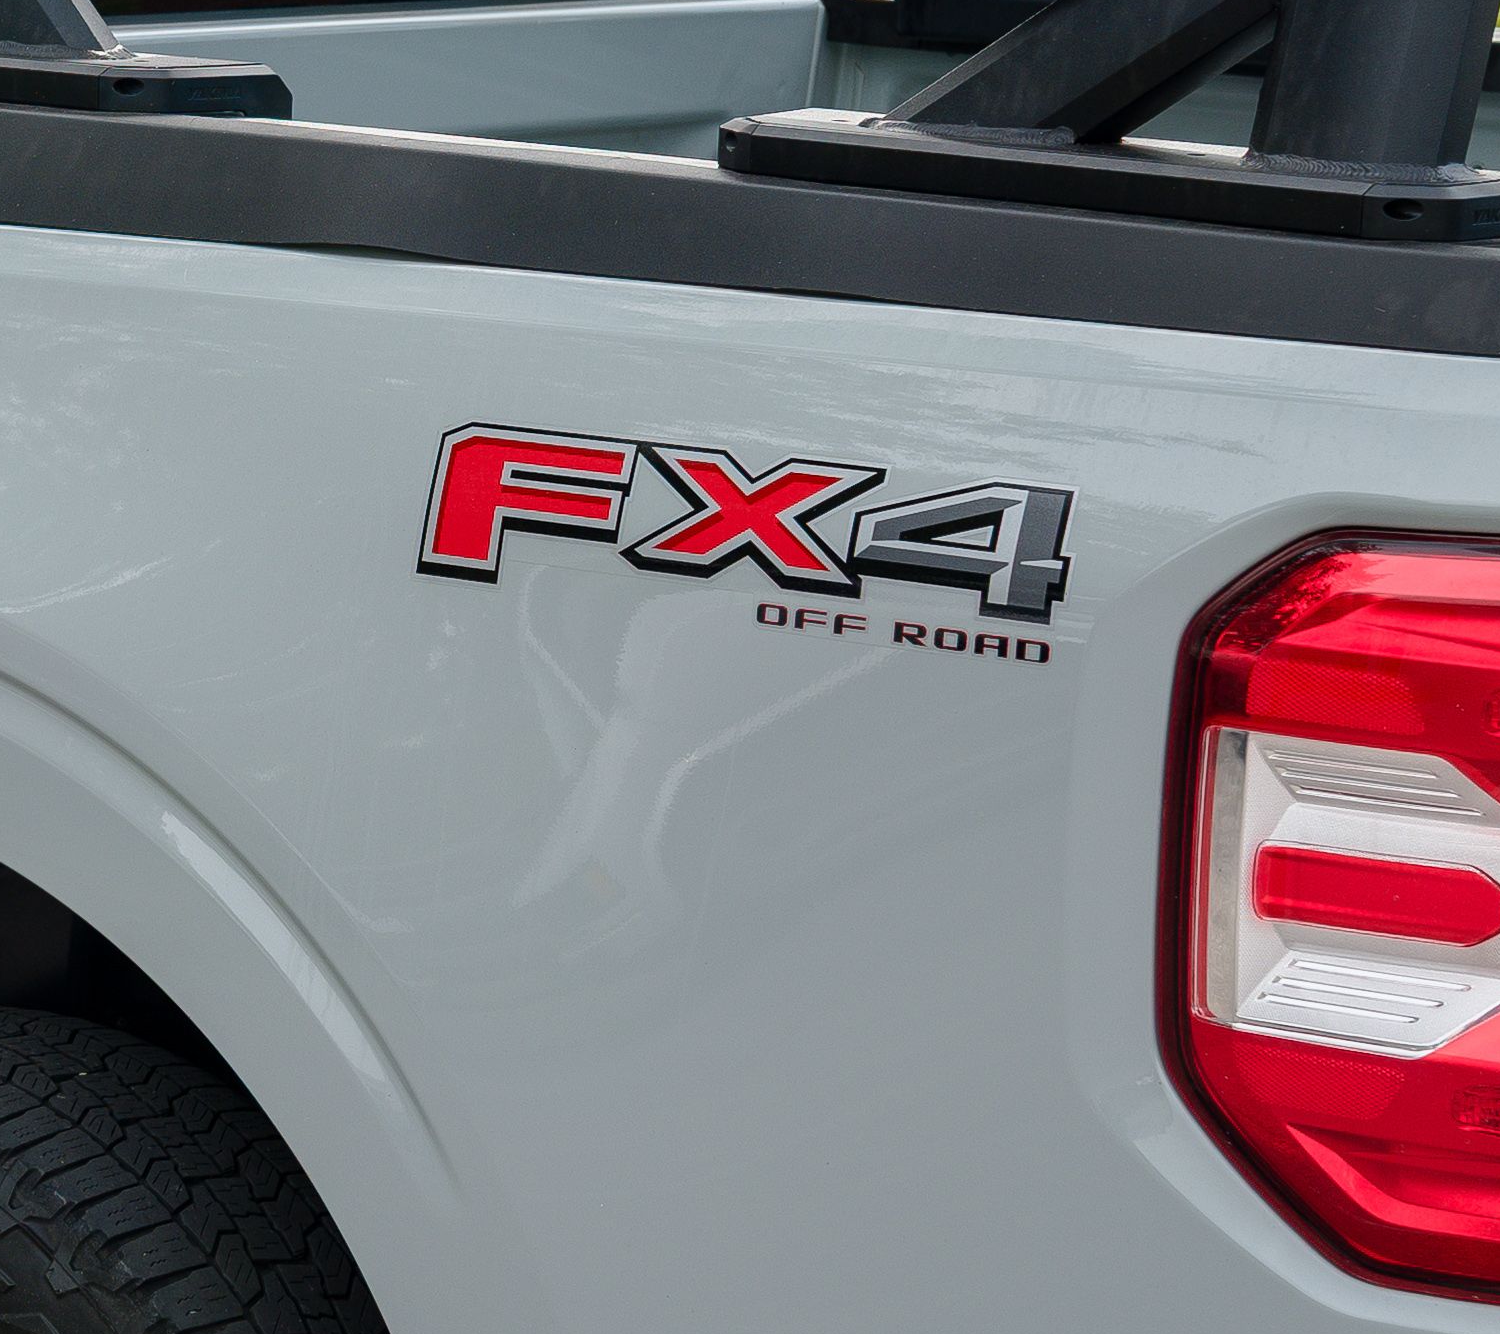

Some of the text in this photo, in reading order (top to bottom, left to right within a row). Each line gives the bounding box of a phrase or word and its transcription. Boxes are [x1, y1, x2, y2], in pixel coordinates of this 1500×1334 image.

[415, 421, 1076, 626] FX4
[756, 603, 1052, 665] OFF ROAD
